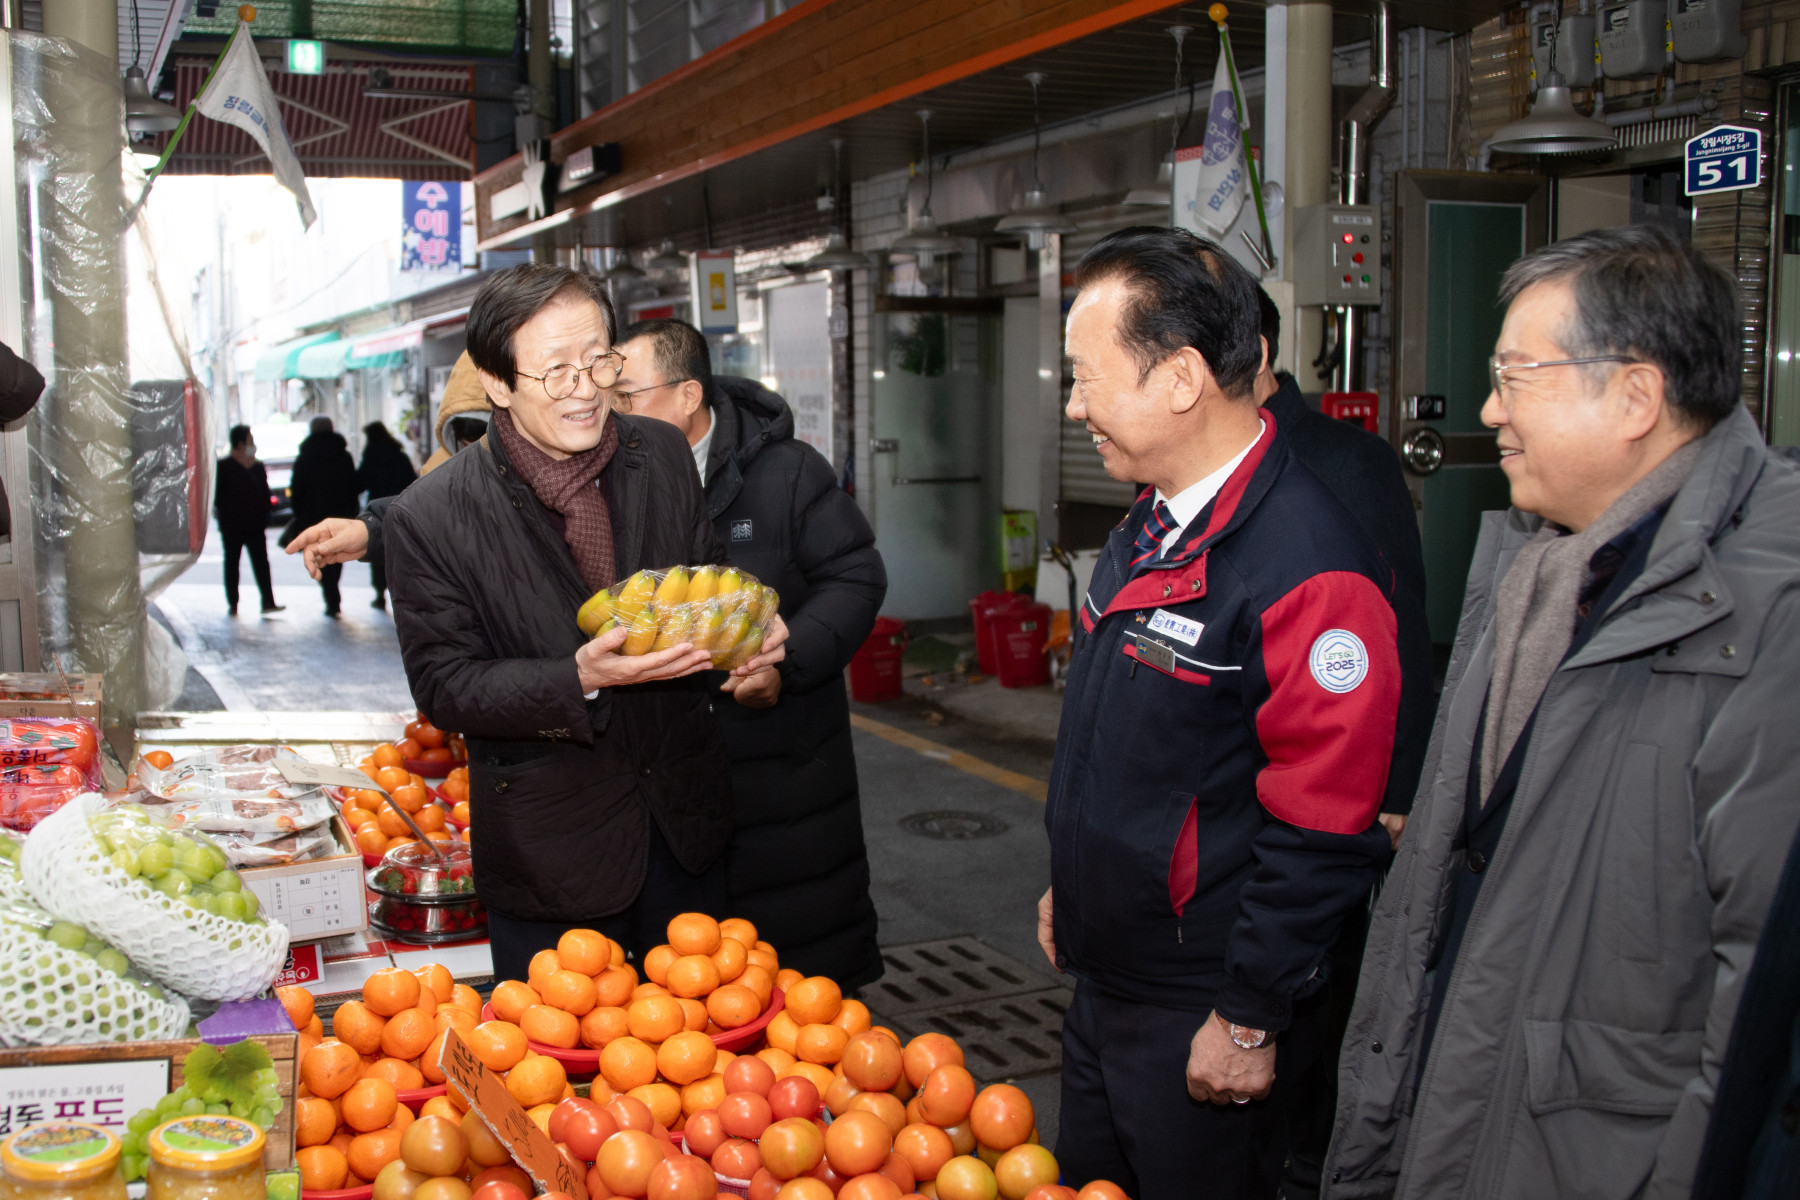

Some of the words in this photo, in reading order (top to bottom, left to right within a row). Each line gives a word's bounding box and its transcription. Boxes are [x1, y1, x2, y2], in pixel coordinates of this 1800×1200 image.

[1695, 144, 1735, 156] Jangnimsijang
[1736, 142, 1750, 150] 5-gil
[1700, 132, 1745, 149] 장림시장5길
[1698, 156, 1747, 187] 51
[414, 181, 450, 265] 수예방
[1325, 660, 1356, 672] 2025
[54, 1097, 125, 1127] 포도
